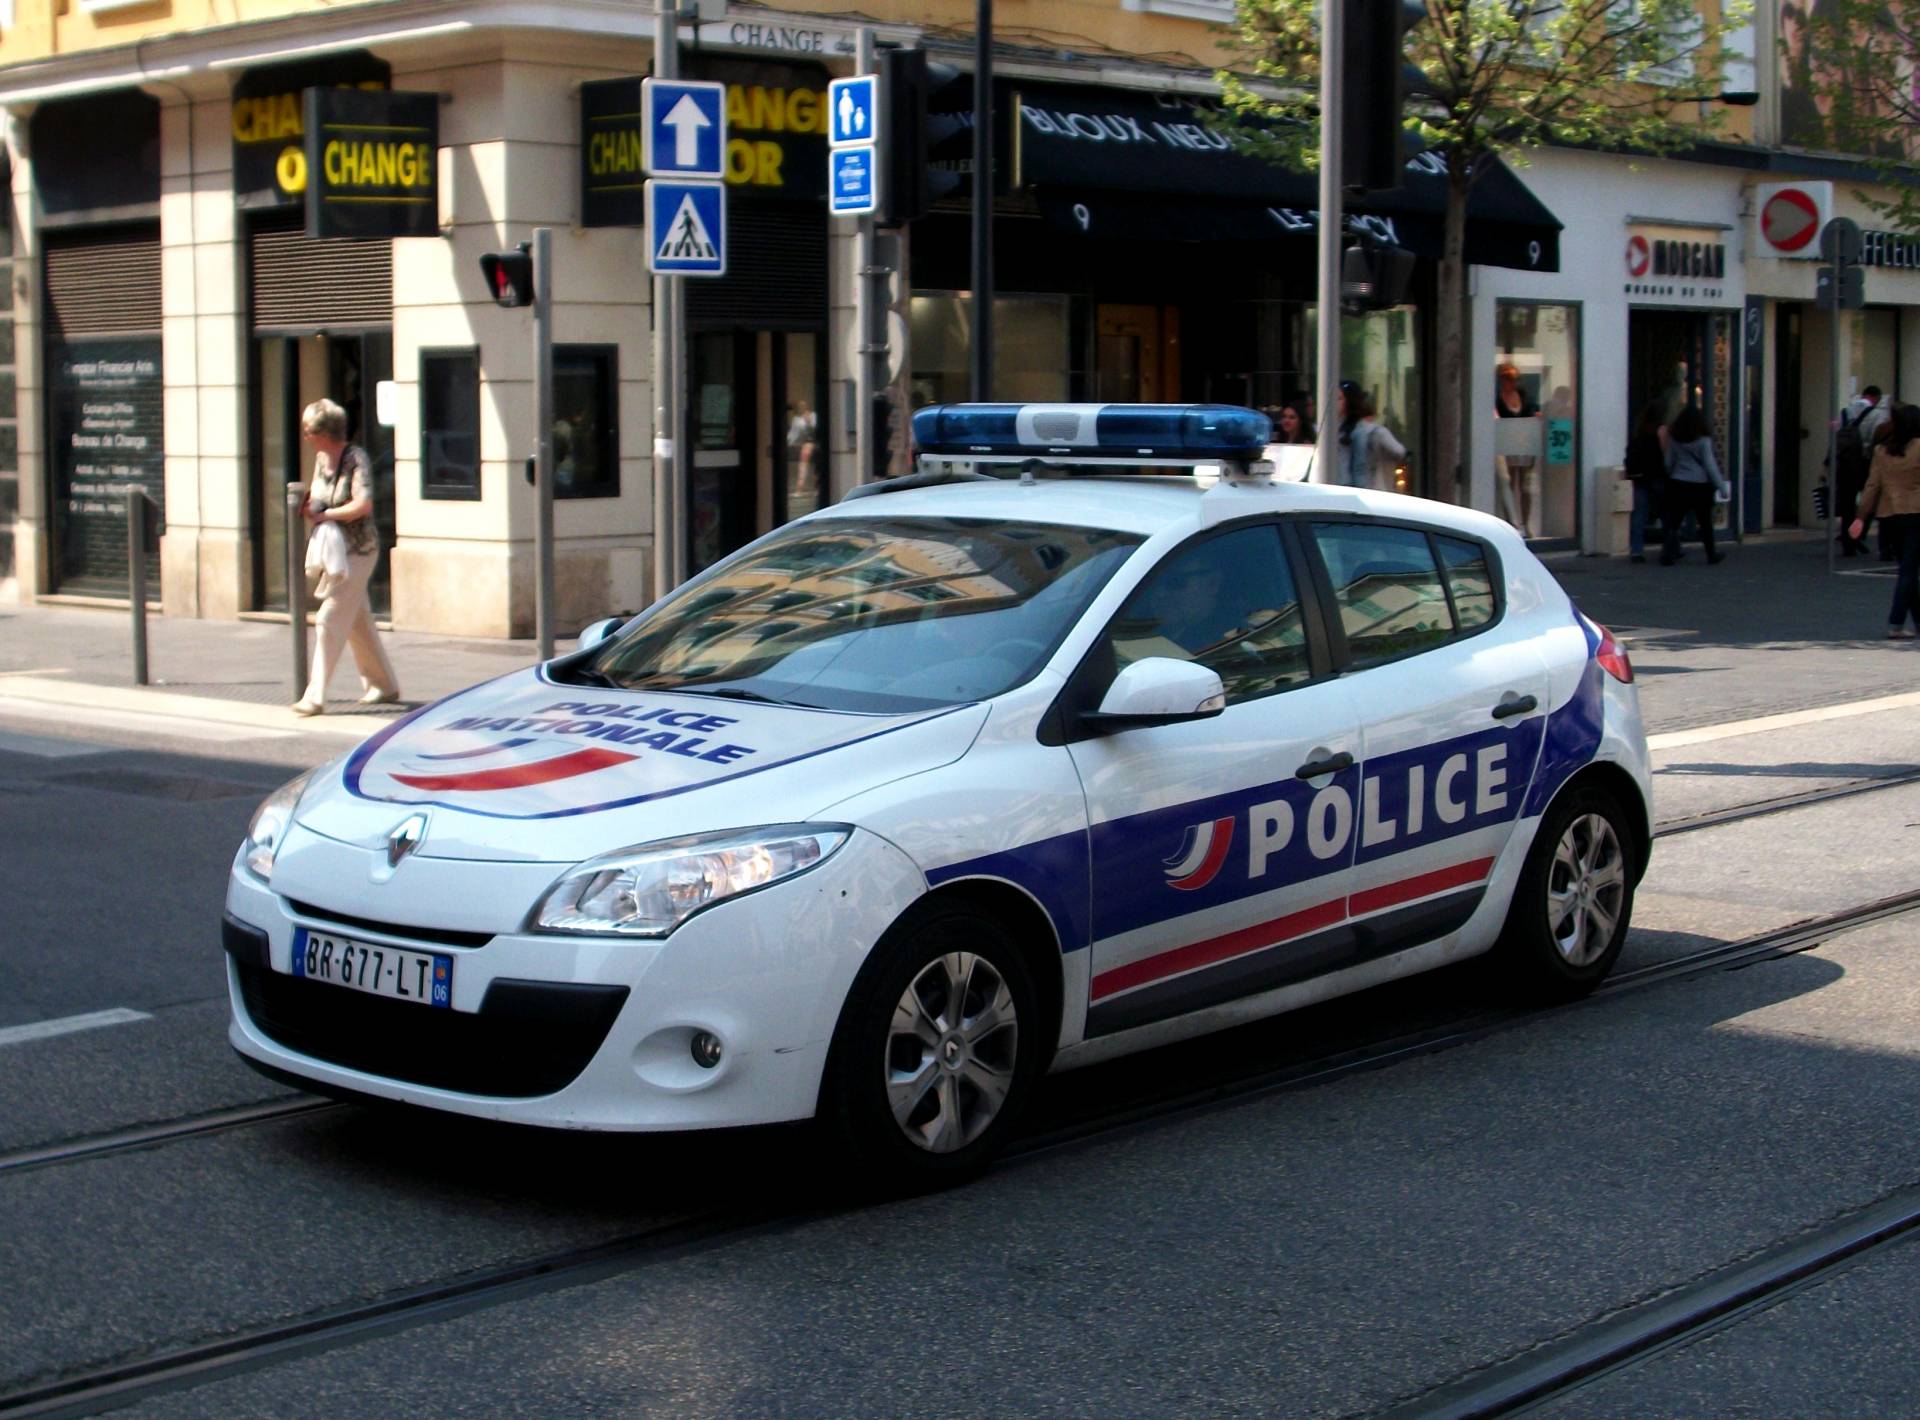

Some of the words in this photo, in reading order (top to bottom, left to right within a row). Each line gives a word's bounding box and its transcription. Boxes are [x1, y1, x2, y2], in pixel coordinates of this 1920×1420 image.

[729, 22, 825, 53] CHANGE
[231, 92, 307, 143] CHA
[726, 84, 829, 134] ANG
[1021, 105, 1157, 142] BIJOUX
[275, 146, 308, 194] O
[324, 140, 431, 187] CHANGE
[590, 129, 642, 175] CHAN
[726, 138, 783, 185] OR
[1073, 203, 1090, 231] 9
[1267, 207, 1313, 230] LE
[1528, 240, 1541, 265] 9
[1653, 239, 1725, 278] MORGAN
[533, 701, 740, 733] POLICE
[437, 717, 757, 765] NATIONALE
[1248, 743, 1508, 880] POLICE
[305, 936, 429, 999] BR-677-LT
[433, 983, 447, 1001] 06
